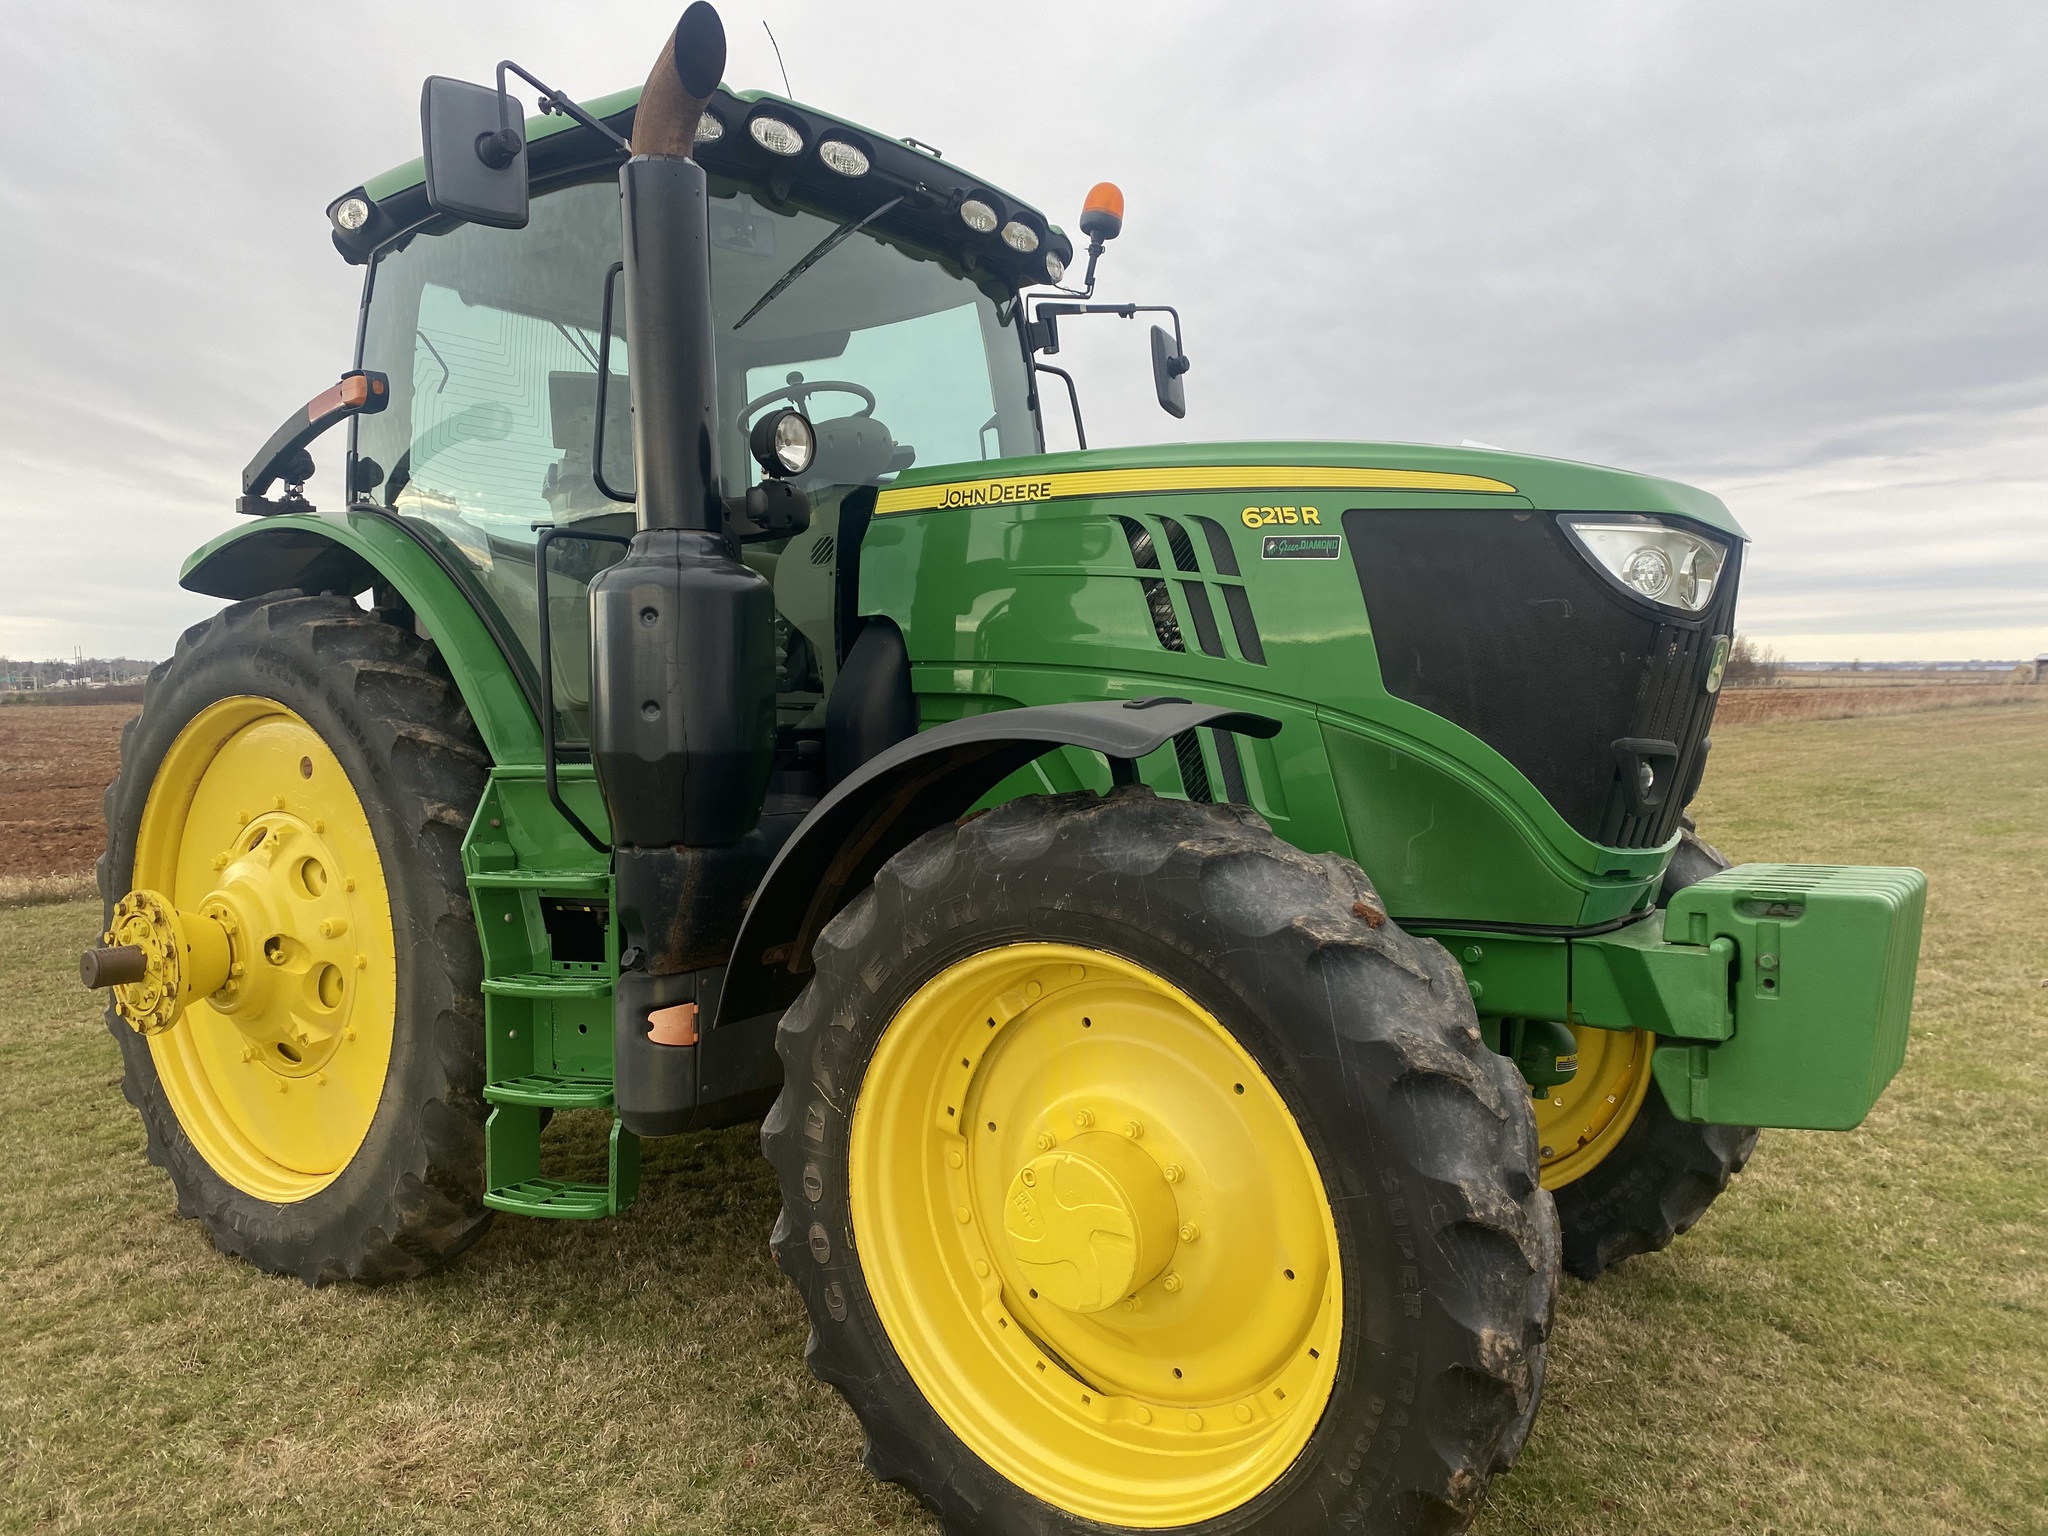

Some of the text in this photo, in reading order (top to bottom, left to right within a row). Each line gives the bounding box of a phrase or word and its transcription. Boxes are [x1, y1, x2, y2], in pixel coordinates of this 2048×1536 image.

[938, 482, 1052, 507] JOHN DEERE
[1300, 540, 1339, 551] DIAMOND
[1339, 1394, 1386, 1487] DT800
